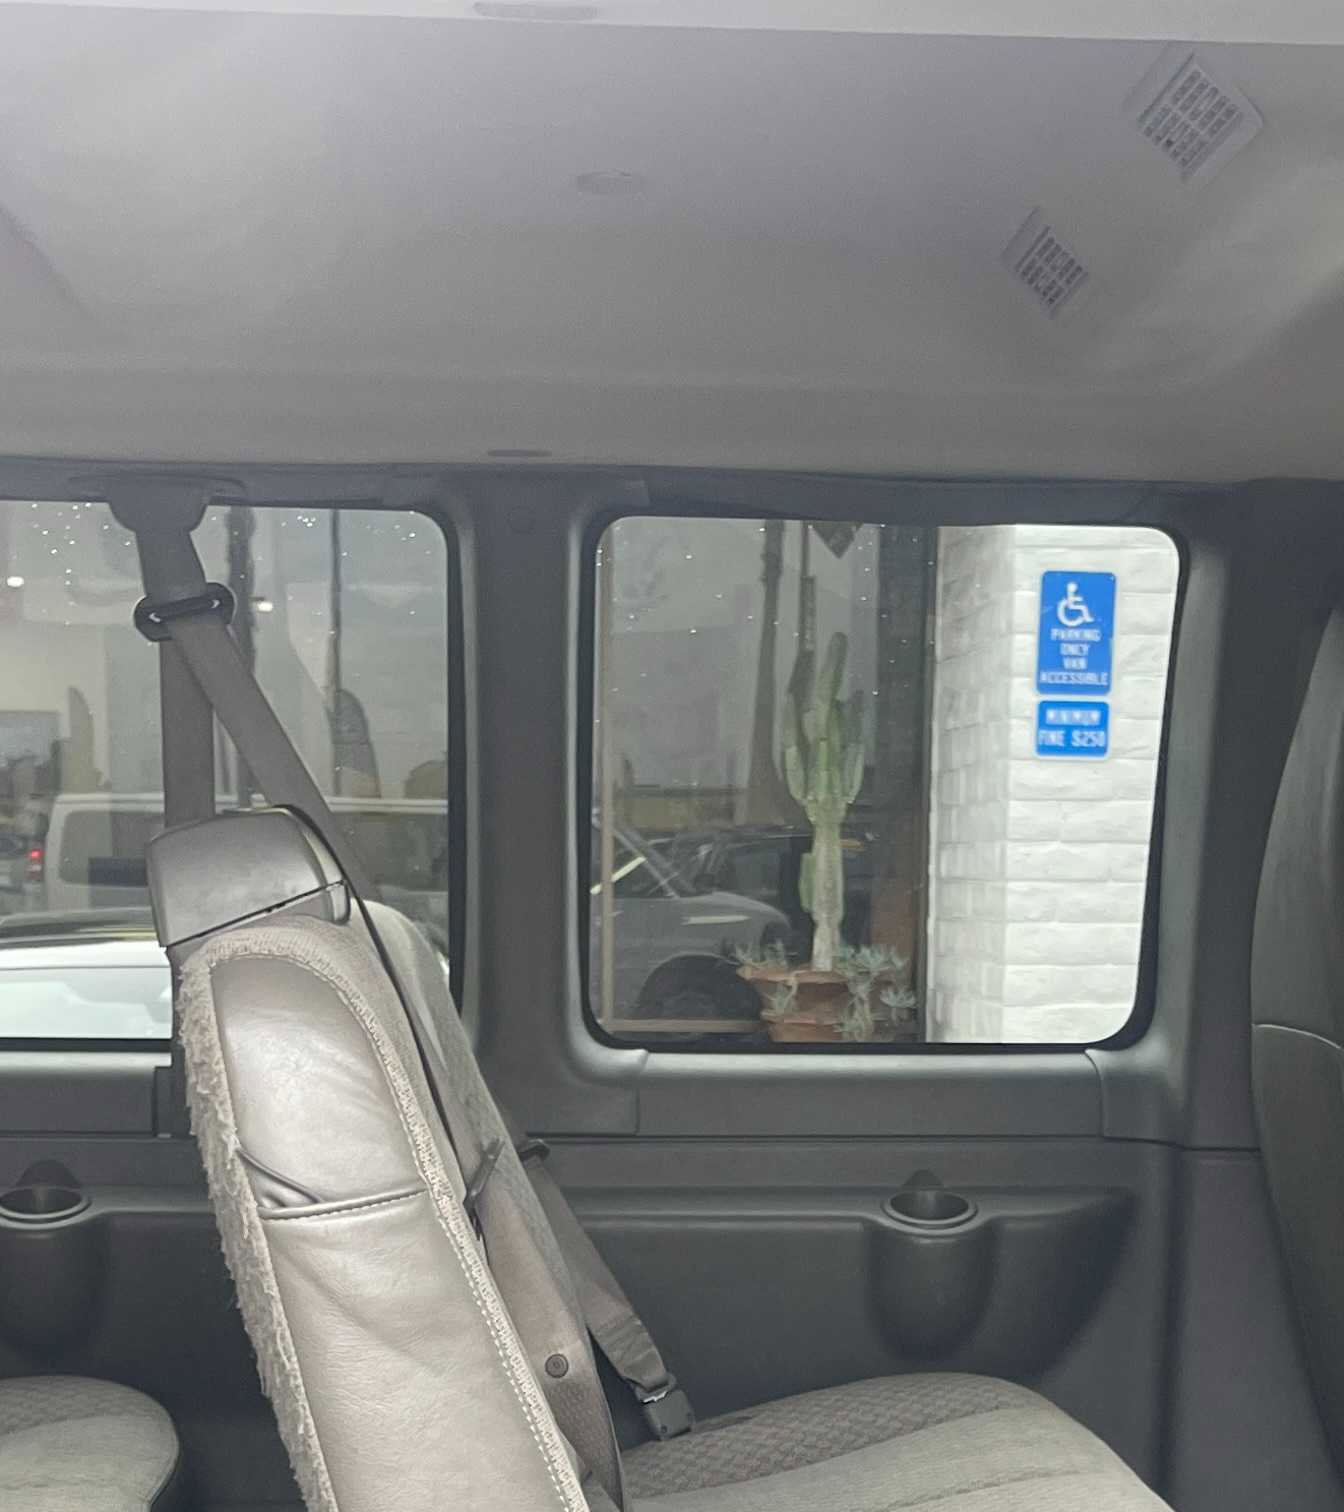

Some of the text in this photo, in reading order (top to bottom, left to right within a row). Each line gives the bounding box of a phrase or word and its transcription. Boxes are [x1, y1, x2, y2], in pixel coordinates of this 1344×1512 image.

[1050, 628, 1102, 642] PARKING
[1059, 643, 1089, 656] ONLY
[1063, 657, 1088, 670] VAN
[1040, 671, 1108, 686] ACCESSIBLE
[1045, 708, 1101, 726] MINIMUM
[1038, 729, 1106, 748] FINE $250
